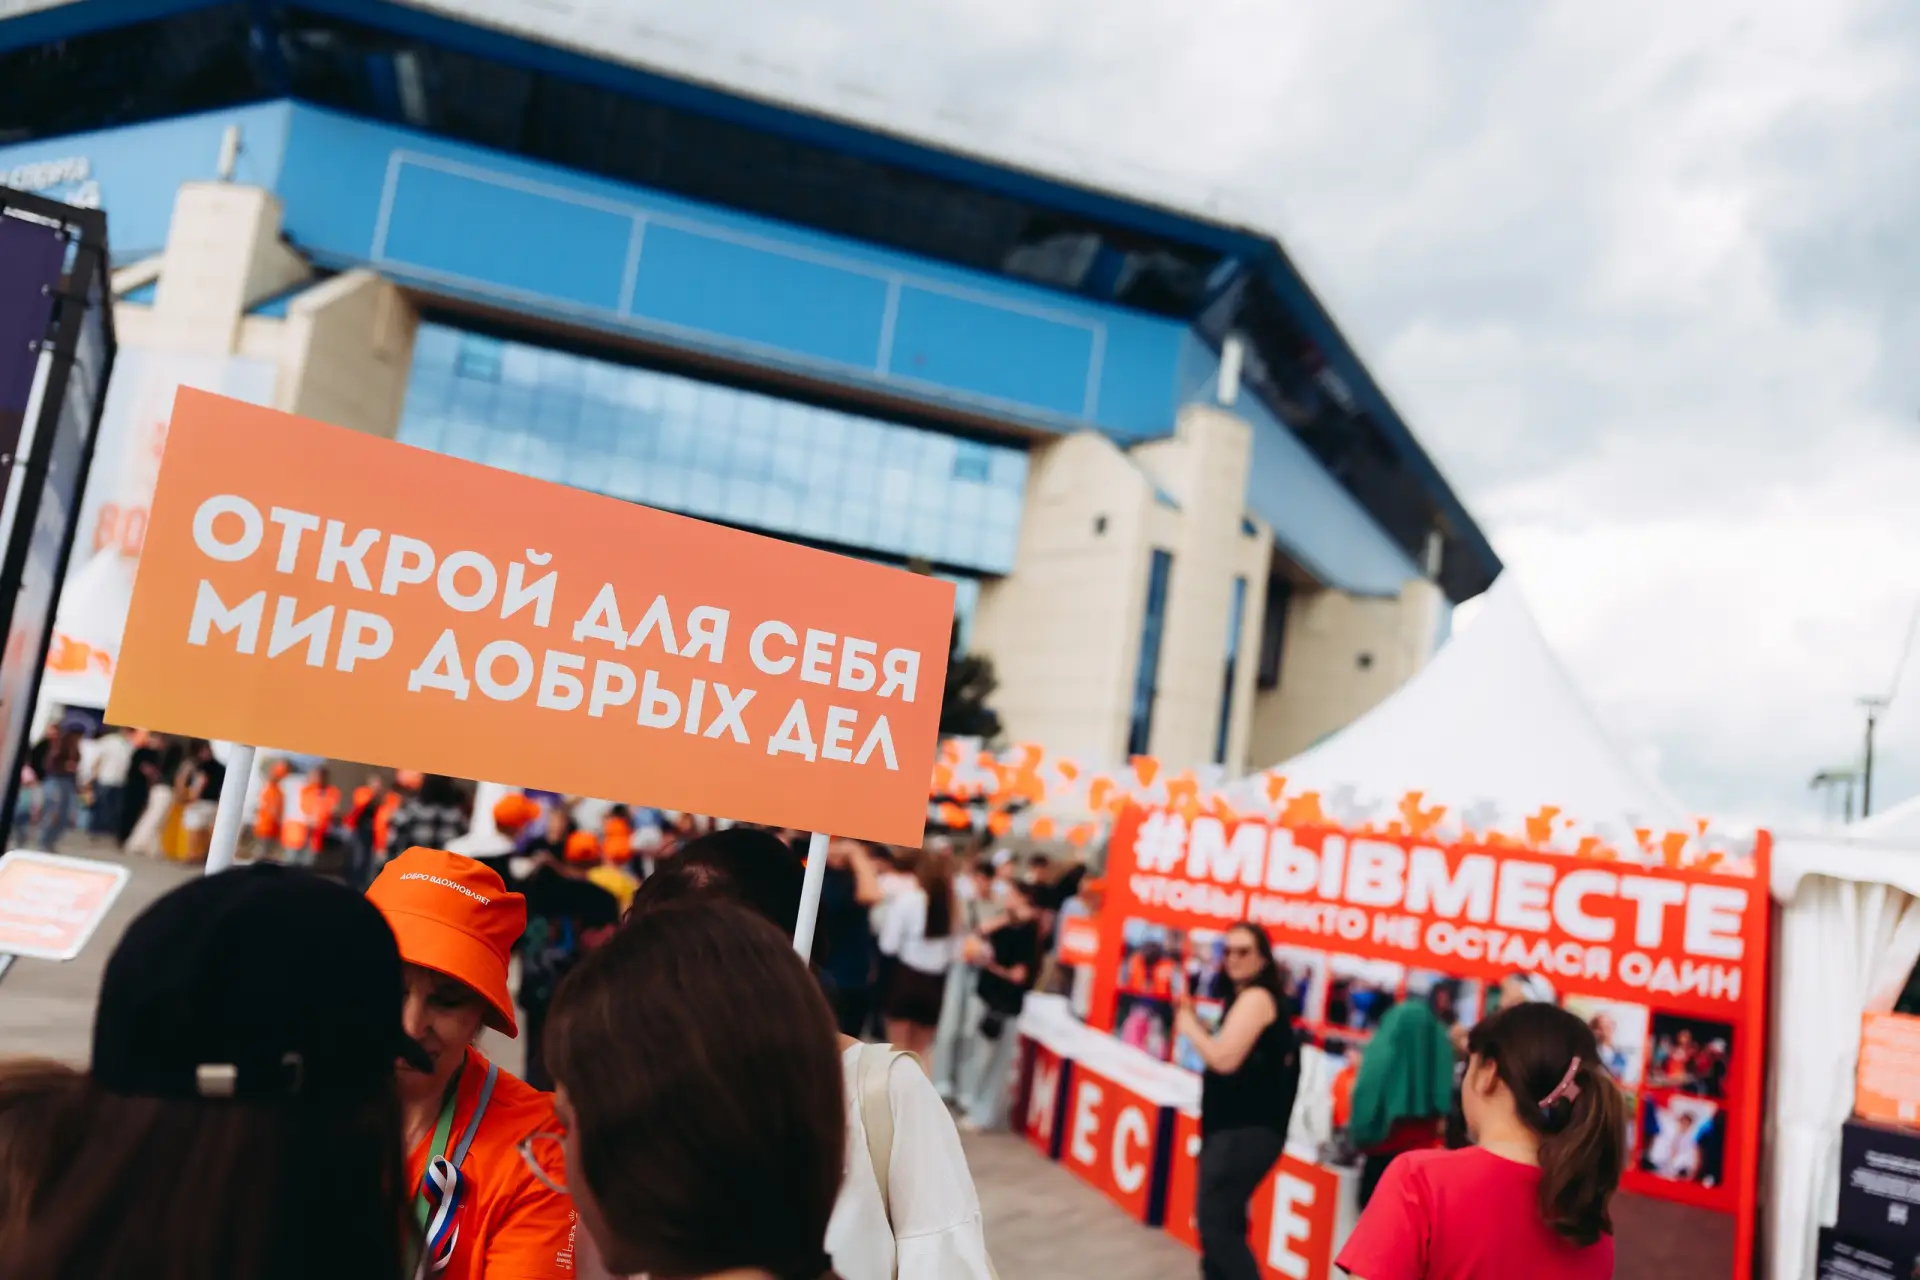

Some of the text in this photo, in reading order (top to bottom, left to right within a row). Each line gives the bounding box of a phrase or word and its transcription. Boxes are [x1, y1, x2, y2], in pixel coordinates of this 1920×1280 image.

[192, 494, 921, 703] ОТКРОЙ ДЛЯ СЕБЯ
[187, 579, 899, 770] МИР ДОБРЫХ ДЕЛ
[400, 873, 491, 906] ДОБРО ВДОХНОВЛЯЕТ
[1130, 874, 1742, 1001] ЧТОБЫ НИКТО НЕ ОСТАЛСЯ ОДИН
[1133, 811, 1748, 960] #МЫВМЕСТЕ
